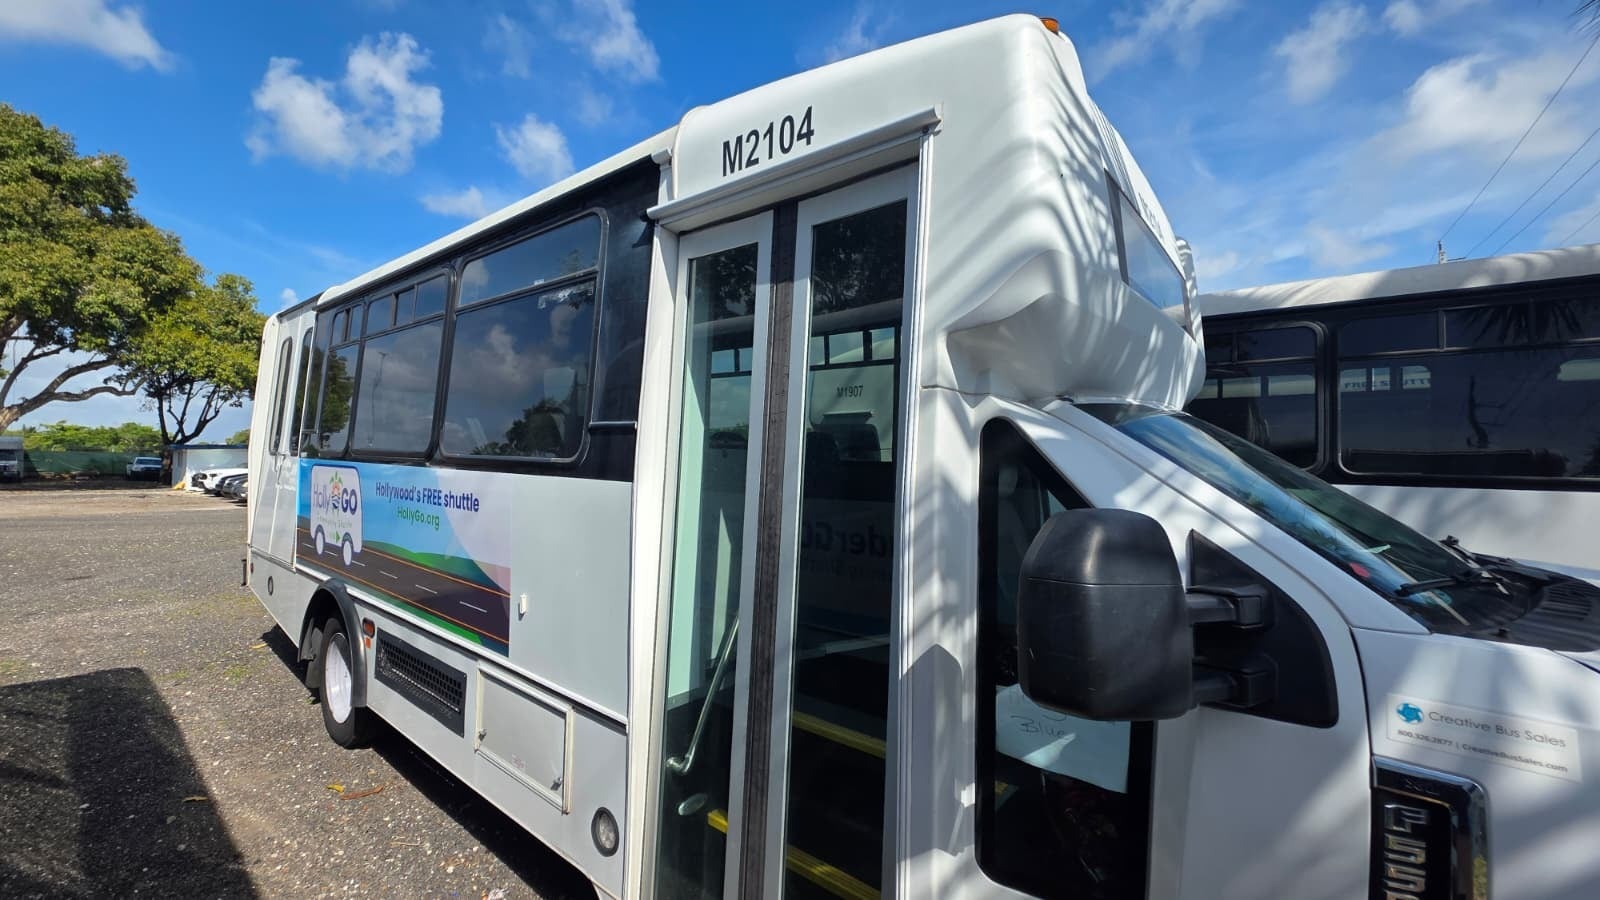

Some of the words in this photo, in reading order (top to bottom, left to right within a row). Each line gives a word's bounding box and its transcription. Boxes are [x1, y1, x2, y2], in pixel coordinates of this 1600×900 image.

[722, 105, 815, 177] M2104
[836, 384, 864, 398] M1907
[313, 482, 331, 515] Holly
[341, 487, 358, 515] GO
[376, 481, 421, 502] Hollywood's
[422, 486, 442, 506] FREE
[443, 491, 480, 512] shuttle
[397, 506, 440, 531] HollyGo.org
[1010, 715, 1066, 738] Blue
[1428, 711, 1491, 732] Creative
[1495, 724, 1521, 739] Bus
[1525, 730, 1567, 748] Sales
[1462, 743, 1568, 773] CreativeBusSales.com
